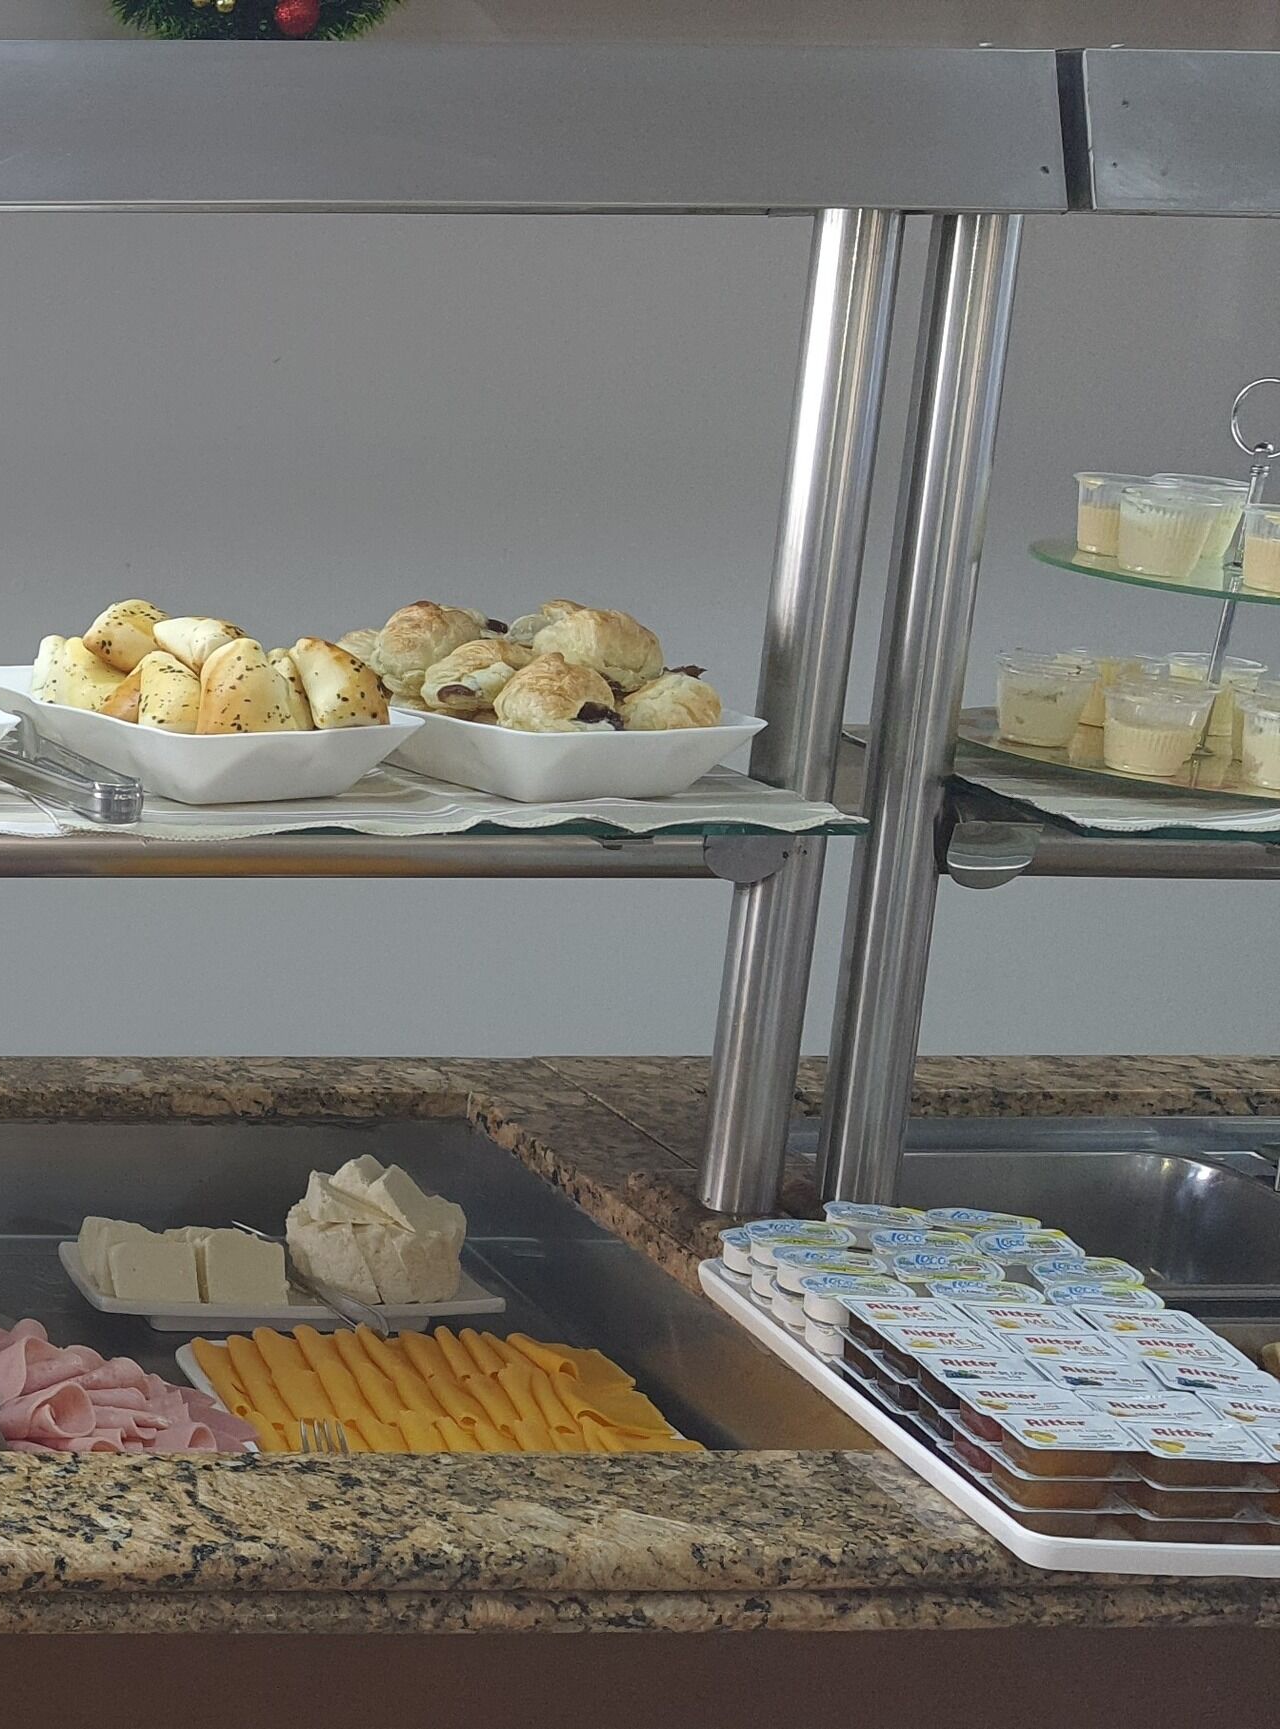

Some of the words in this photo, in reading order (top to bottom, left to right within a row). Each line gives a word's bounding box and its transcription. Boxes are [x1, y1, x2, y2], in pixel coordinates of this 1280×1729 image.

[866, 1302, 922, 1312] Ritter
[986, 1309, 1043, 1318] Ritter
[1104, 1313, 1162, 1322] Ritter
[901, 1328, 957, 1338] Ritter
[1025, 1336, 1083, 1346] Ritter
[1137, 1339, 1197, 1349] Ritter
[1065, 1345, 1104, 1353] MEL
[1176, 1348, 1217, 1357] MEL
[939, 1358, 998, 1368] Ritter
[1059, 1365, 1119, 1375] Ritter
[1177, 1367, 1241, 1382] Ritter
[977, 1390, 1038, 1400] Ritter
[1107, 1400, 1168, 1410] Ritter
[1024, 1418, 1086, 1427] Ritter
[1151, 1427, 1216, 1438] Ritter
